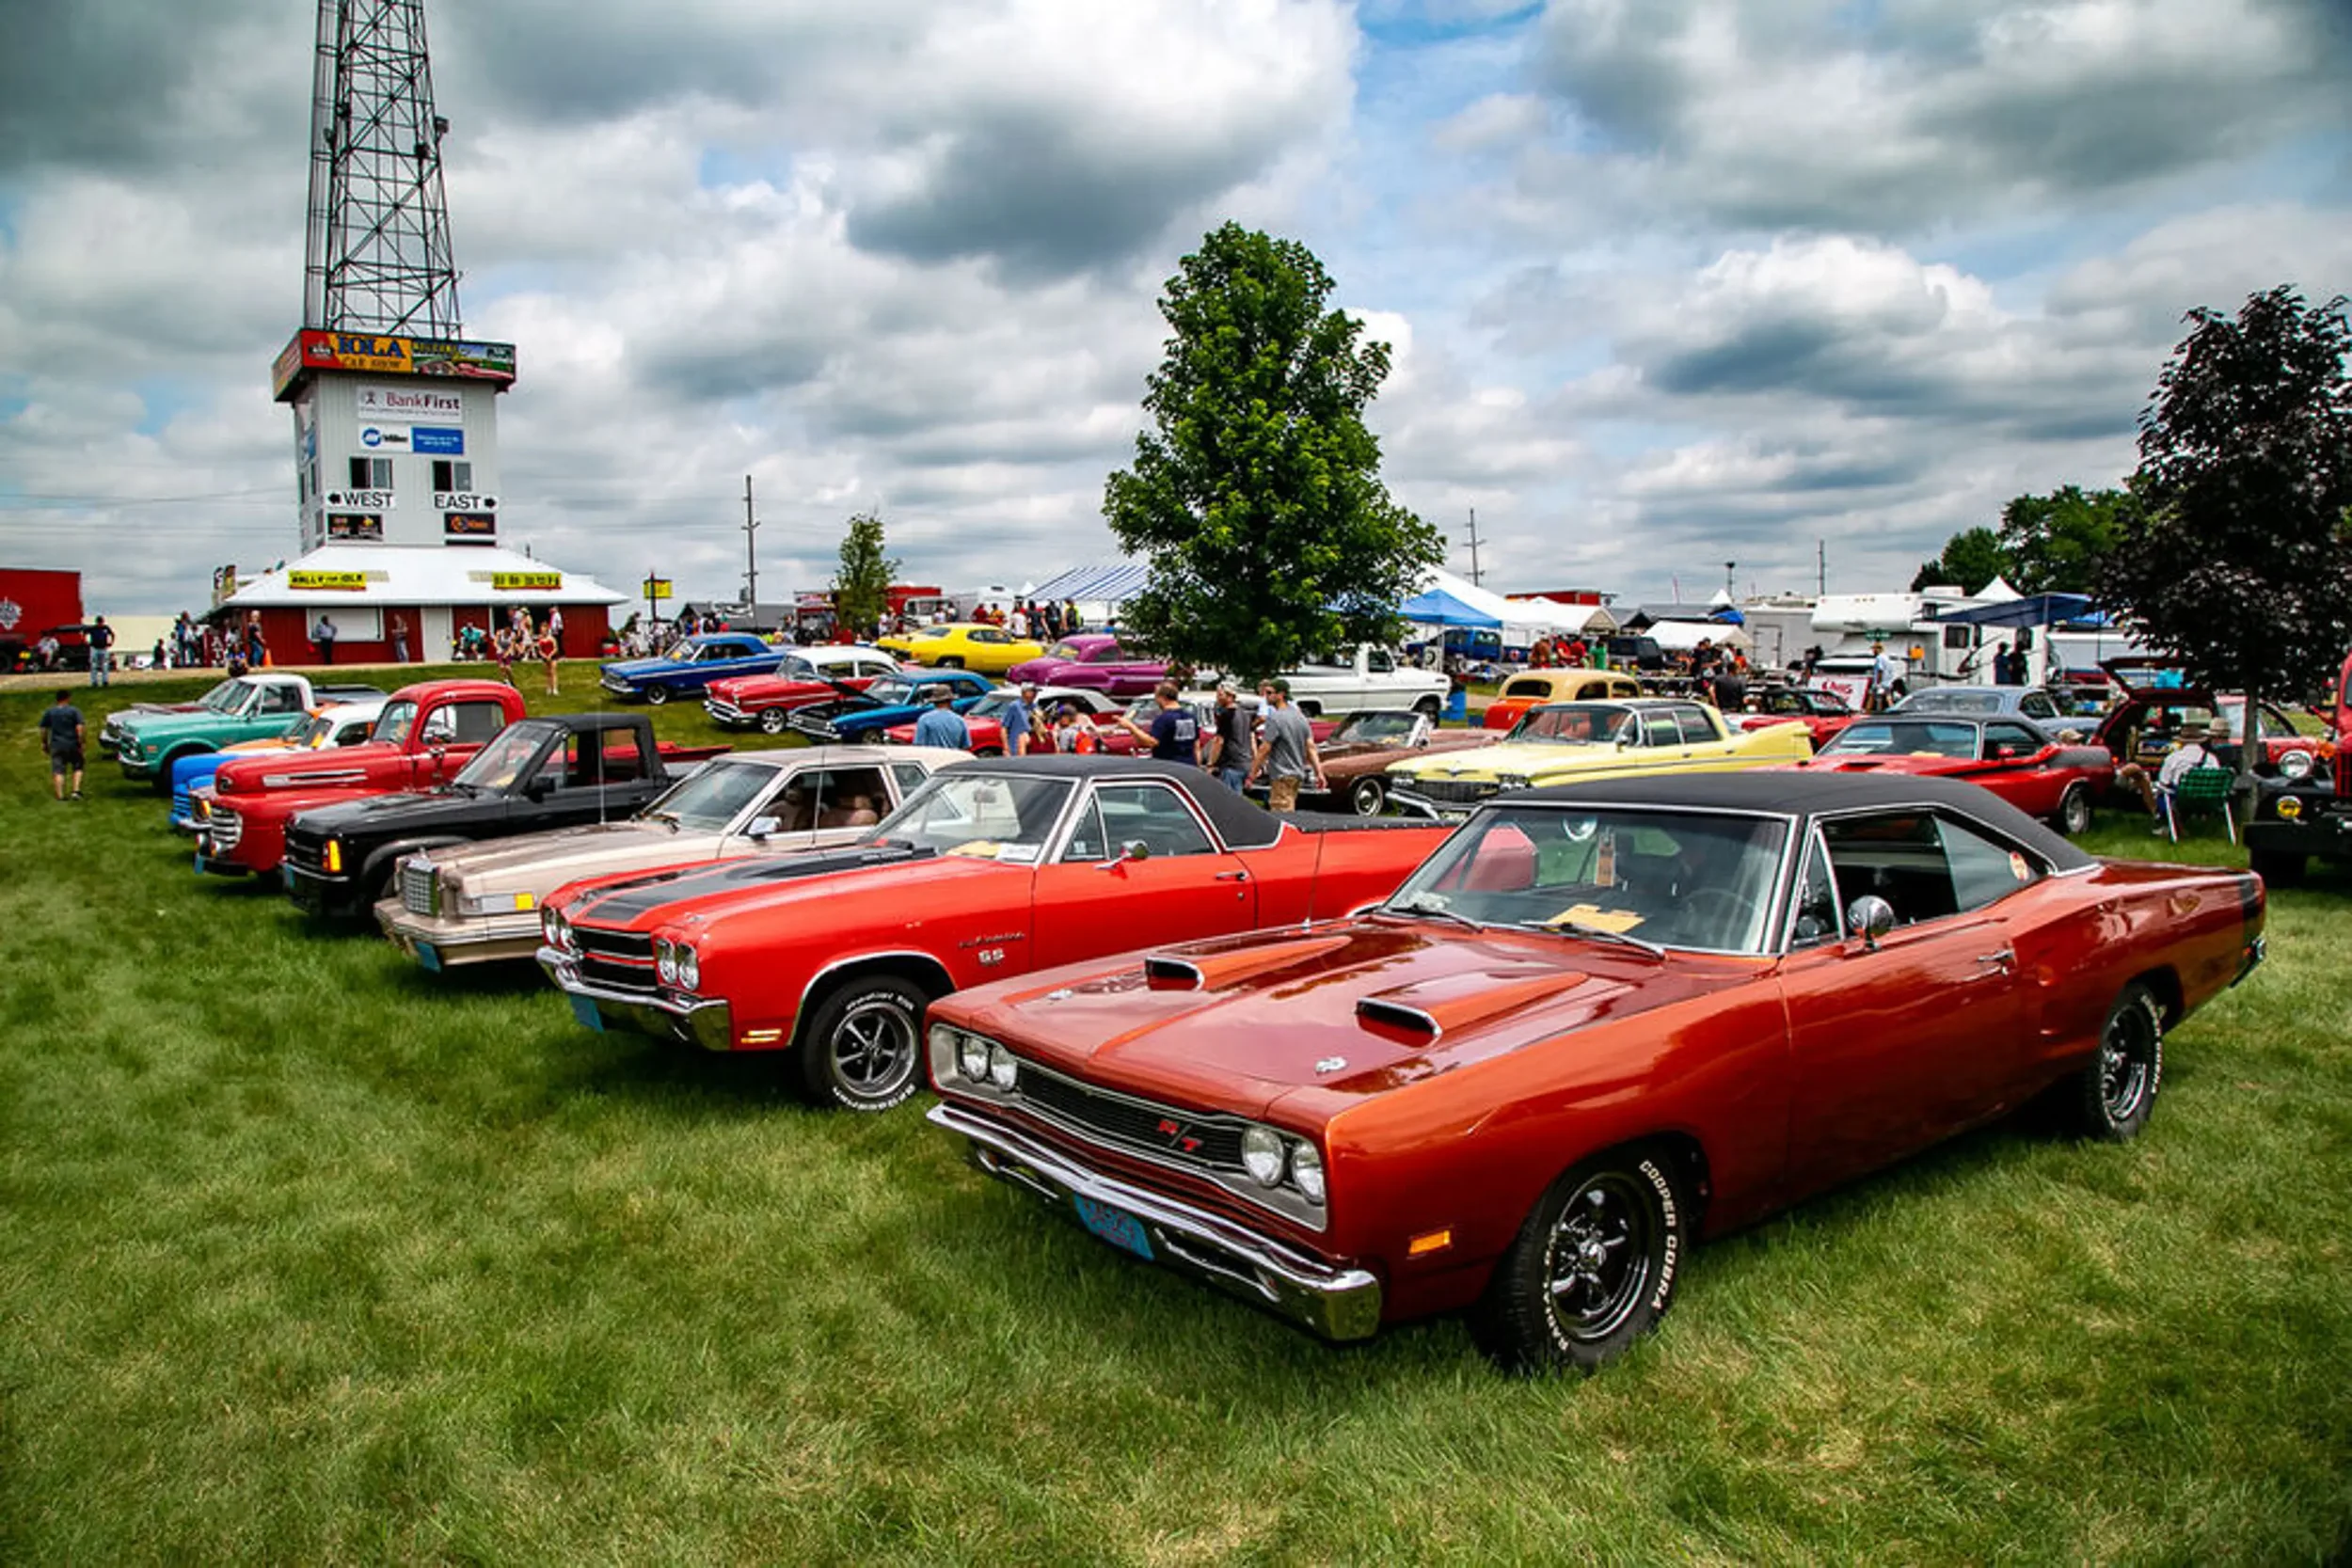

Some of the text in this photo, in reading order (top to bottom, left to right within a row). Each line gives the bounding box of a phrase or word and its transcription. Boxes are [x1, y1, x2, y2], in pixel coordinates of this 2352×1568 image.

[336, 335, 405, 358] IOLA
[386, 391, 460, 409] BankFirst
[343, 492, 393, 508] WEST
[434, 494, 481, 510] EAST
[1157, 1119, 1204, 1153] R/T
[1639, 1159, 1677, 1310] COOPER COBRA
